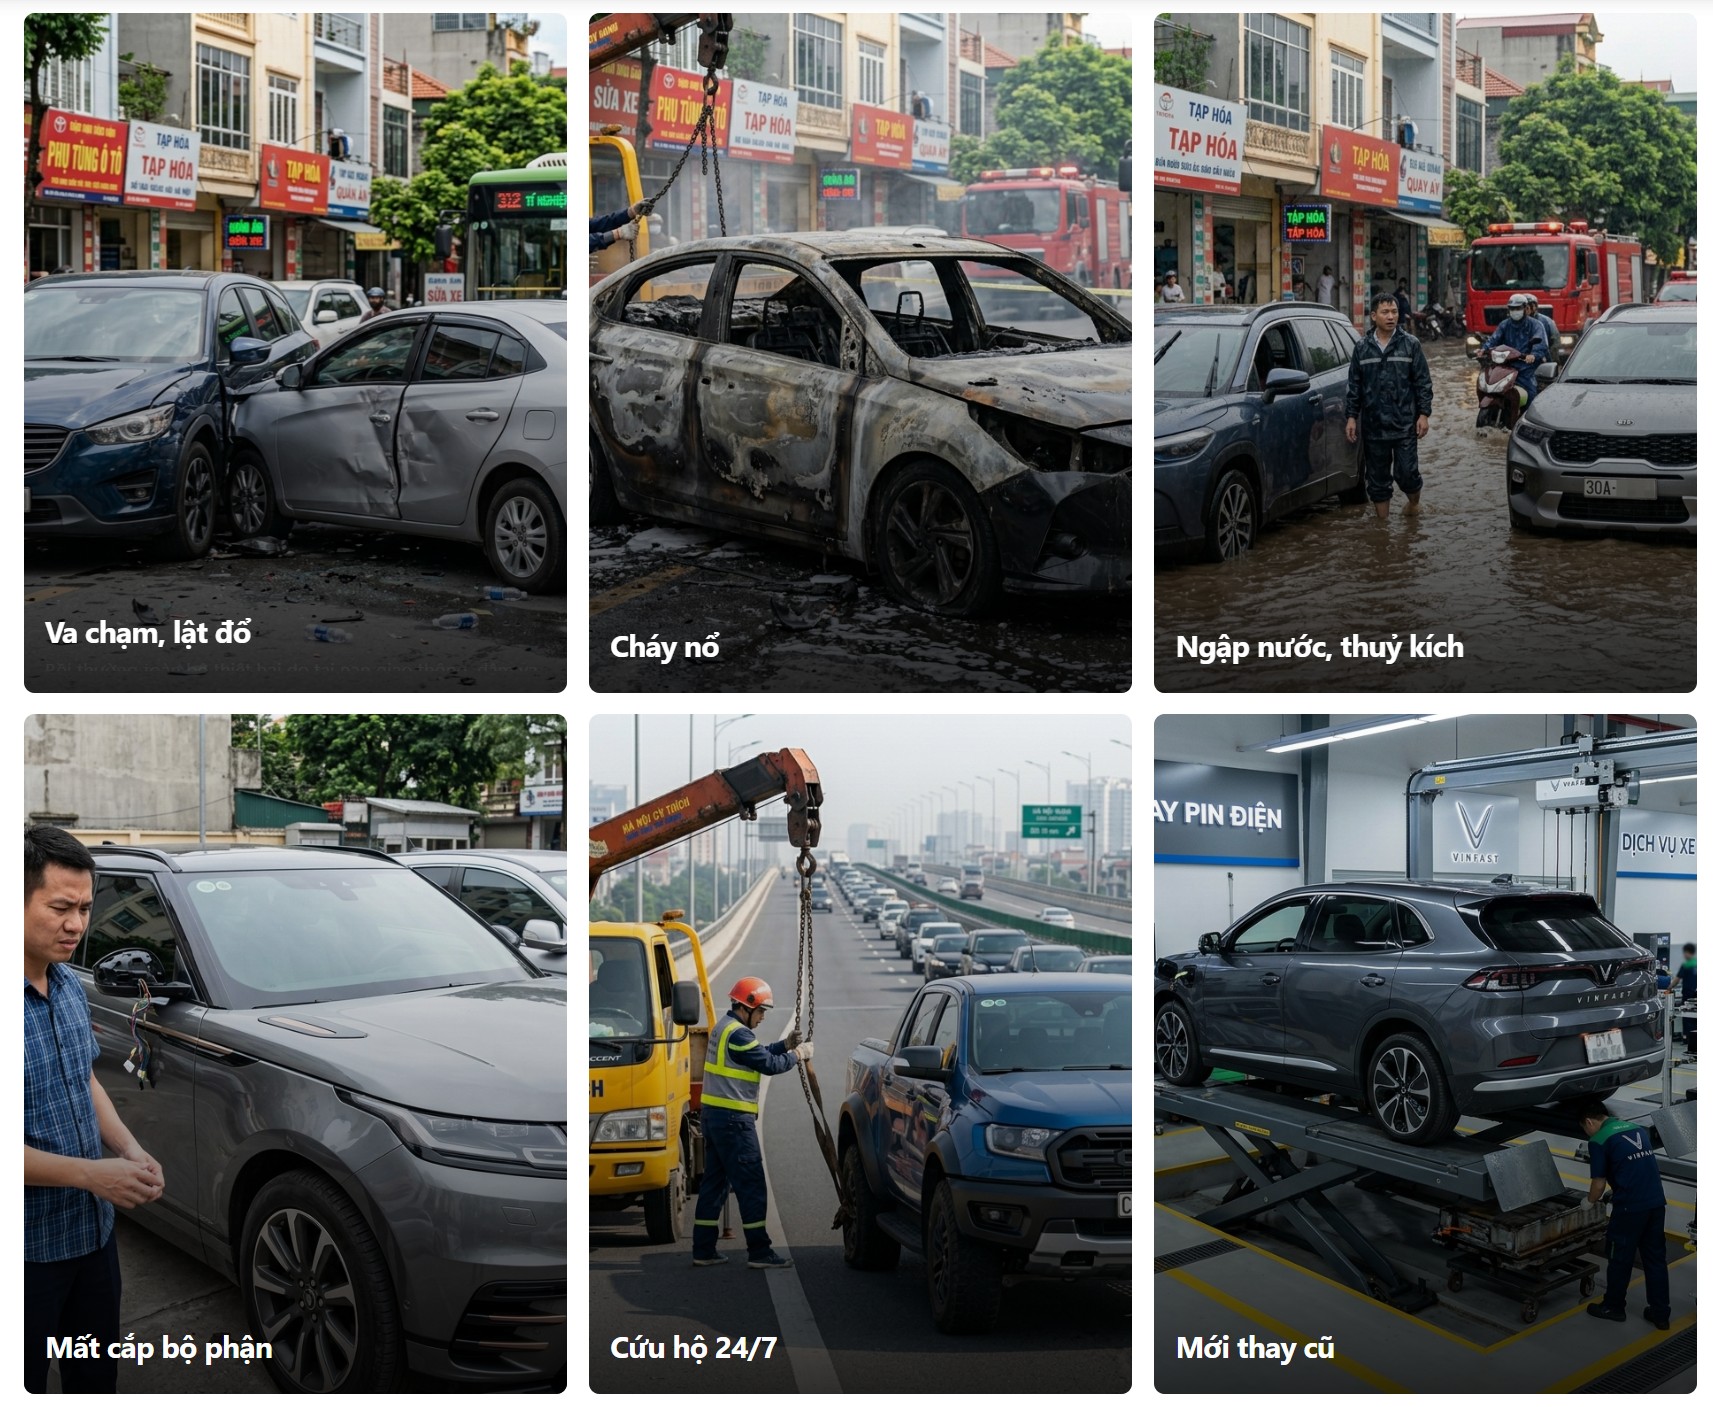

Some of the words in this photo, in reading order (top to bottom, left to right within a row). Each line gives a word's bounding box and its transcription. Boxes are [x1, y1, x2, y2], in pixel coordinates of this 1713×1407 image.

[623, 90, 640, 115] XE
[758, 91, 772, 107] TẠP
[657, 96, 679, 128] PHỤ
[744, 111, 767, 135] TẠP
[769, 113, 792, 136] HÓA
[1189, 101, 1209, 121] TẠP
[1211, 105, 1232, 125] HÓA
[156, 132, 172, 151] TẠP
[174, 133, 190, 150] HÓA
[1169, 127, 1202, 156] TẠP
[1205, 132, 1238, 161] HÓA
[48, 140, 70, 174] PHỤ
[142, 155, 166, 181] TẠP
[169, 157, 194, 181] HÓA
[1352, 145, 1369, 171] TẠP
[1371, 149, 1390, 172] HÓA
[286, 159, 304, 184] TẠP
[1184, 802, 1224, 826] PIN
[1229, 801, 1282, 833] ĐIỆN
[1452, 852, 1499, 864] VINFAST
[1622, 833, 1654, 856] DỊCH
[1658, 835, 1676, 858] VỤ
[1680, 837, 1695, 855] XE
